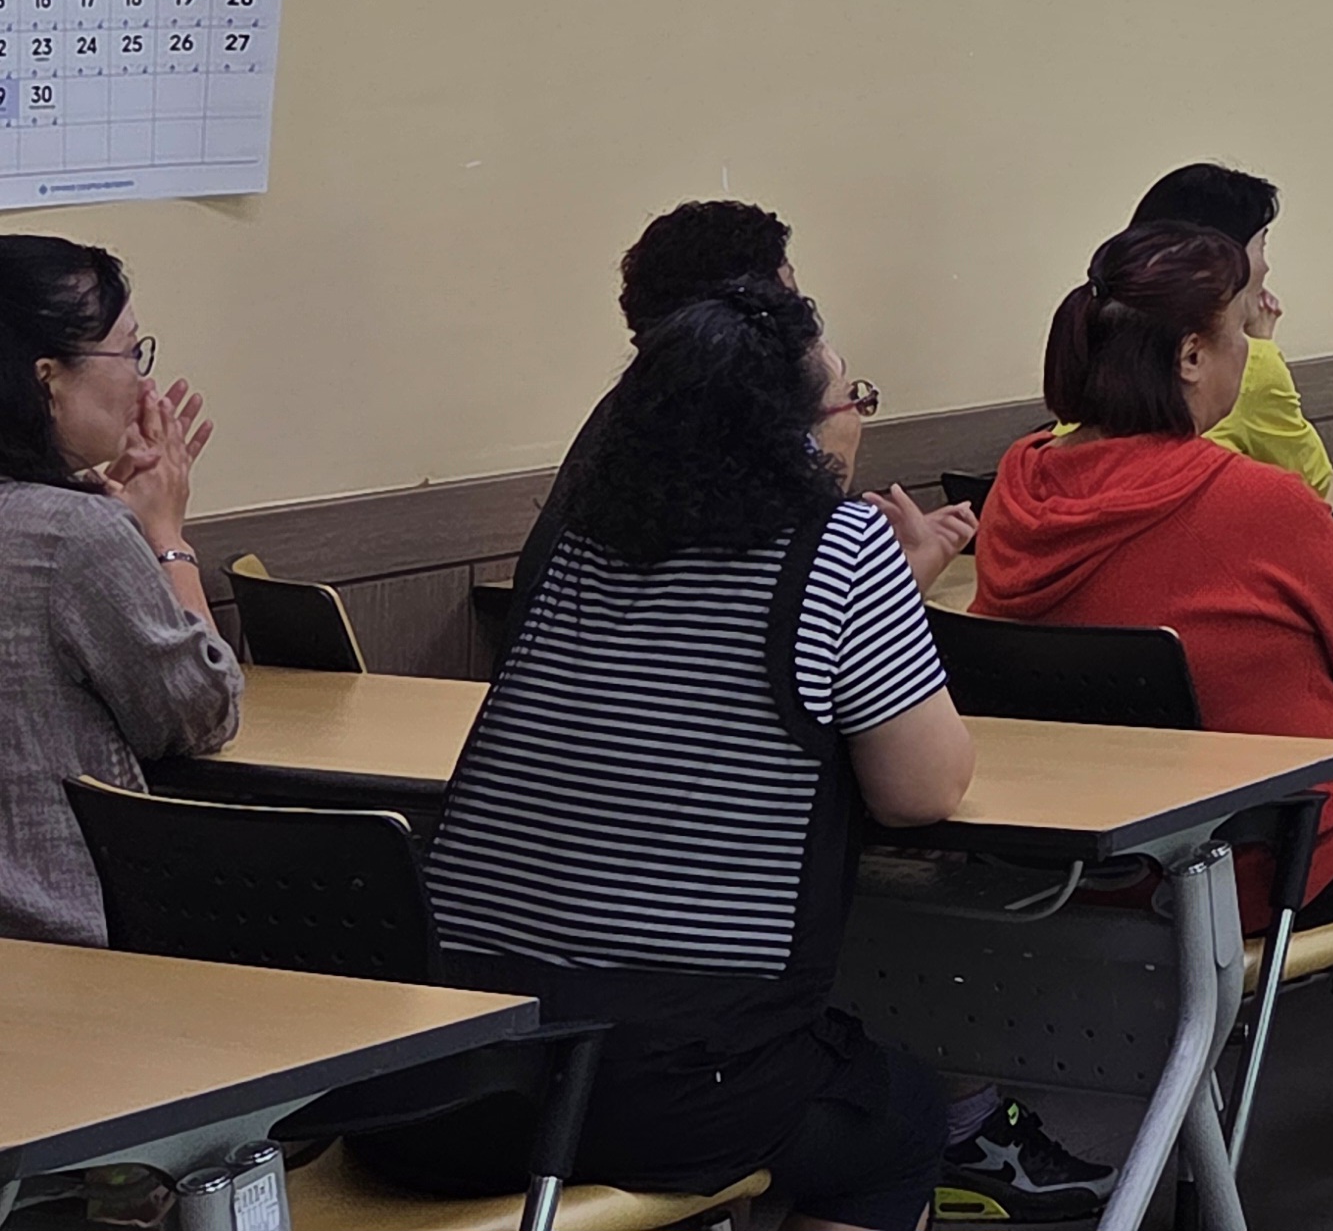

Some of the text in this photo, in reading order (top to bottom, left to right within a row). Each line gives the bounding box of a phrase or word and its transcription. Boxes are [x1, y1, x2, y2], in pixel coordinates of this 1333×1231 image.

[31, 37, 53, 56] 23
[76, 37, 98, 55] 24
[121, 35, 143, 53] 25
[169, 34, 194, 52] 26
[224, 33, 251, 52] 27
[31, 85, 53, 104] 30
